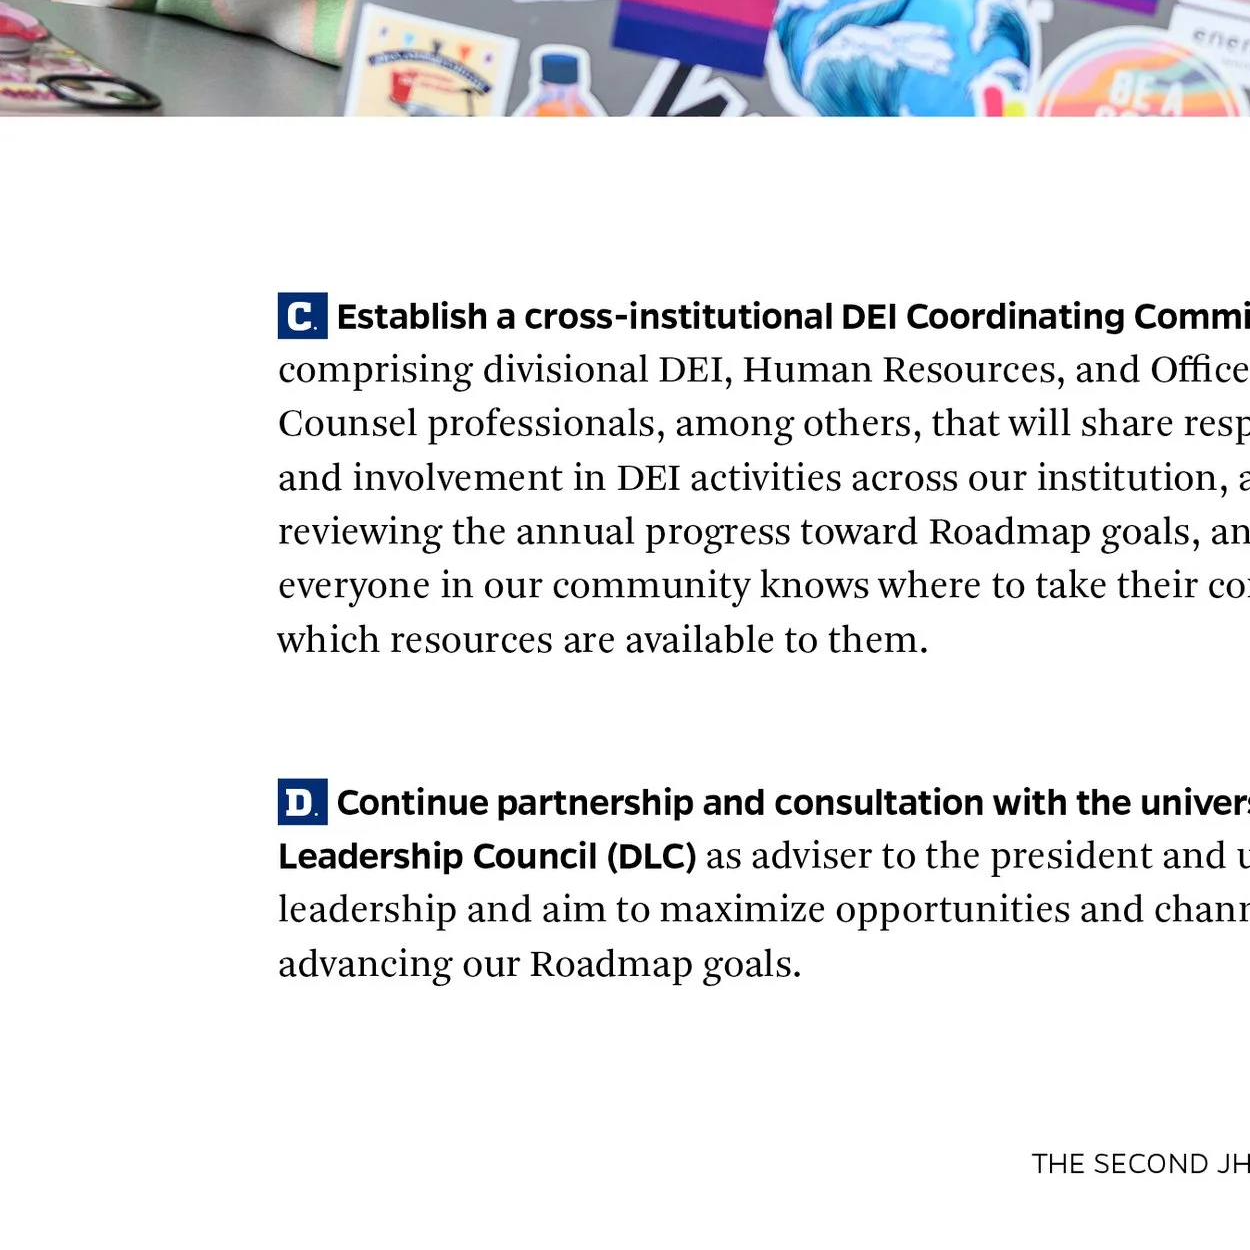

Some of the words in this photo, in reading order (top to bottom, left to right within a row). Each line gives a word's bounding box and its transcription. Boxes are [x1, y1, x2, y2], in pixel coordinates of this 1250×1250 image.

[1109, 69, 1156, 112] BE
[339, 301, 486, 329] Establish
[497, 309, 515, 329] a
[525, 301, 832, 329] cross-institutional
[843, 303, 895, 329] DEI
[907, 301, 1124, 334] Coordinating
[279, 354, 473, 392] comprising
[484, 354, 648, 383] divisional
[659, 357, 732, 389] DEI,
[744, 357, 872, 383] Human
[883, 357, 1064, 389] Resources,
[1077, 354, 1140, 383] and
[1152, 353, 1248, 383] Office
[279, 408, 417, 436] Counsel
[428, 407, 664, 445] professionals,
[677, 416, 795, 446] among
[804, 408, 920, 443] others,
[932, 408, 1000, 436] that
[1008, 407, 1071, 436] will
[1082, 408, 1172, 436] share
[279, 462, 342, 491] and
[353, 462, 563, 491] involvement
[574, 462, 606, 490] in
[618, 465, 680, 490] DEI
[691, 462, 841, 491] activities
[853, 471, 957, 491] across
[969, 471, 1027, 491] our
[1038, 462, 1227, 498] institution,
[279, 516, 443, 554] reviewing
[453, 516, 505, 545] the
[517, 516, 634, 545] annual
[646, 525, 790, 554] progress
[801, 516, 918, 545] toward
[930, 516, 1090, 553] Roadmap
[1101, 516, 1199, 554] goals,
[279, 578, 429, 608] everyone
[441, 569, 473, 598] in
[485, 578, 543, 598] our
[553, 569, 751, 608] community
[761, 569, 869, 598] knows
[878, 570, 980, 598] where
[992, 573, 1024, 598] to
[1036, 569, 1106, 598] take
[1117, 569, 1198, 598] their
[277, 624, 380, 653] which
[391, 633, 552, 653] resources
[565, 633, 614, 653] are
[627, 624, 773, 653] available
[785, 628, 817, 653] to
[829, 624, 927, 653] them.
[338, 787, 488, 815] Continue
[498, 787, 693, 821] partnership
[703, 789, 764, 815] and
[775, 787, 983, 815] consultation
[993, 787, 1066, 815] with
[1076, 789, 1131, 815] the
[280, 841, 463, 875] Leadership
[474, 841, 596, 869] Council
[608, 842, 696, 874] (DLC)
[707, 849, 741, 869] as
[753, 840, 872, 869] adviser
[882, 843, 915, 869] to
[926, 840, 979, 869] the
[991, 840, 1153, 877] president
[1164, 840, 1226, 869] and
[279, 893, 456, 931] leadership
[468, 894, 532, 922] and
[543, 893, 606, 922] aim
[617, 897, 649, 922] to
[661, 893, 824, 922] maximize
[837, 893, 1069, 931] opportunities
[1081, 894, 1144, 922] and
[279, 948, 453, 986] advancing
[463, 957, 520, 977] our
[531, 948, 692, 985] Roadmap
[703, 948, 800, 986] goals.
[1032, 1153, 1084, 1173] THE
[1095, 1153, 1208, 1173] SECOND
